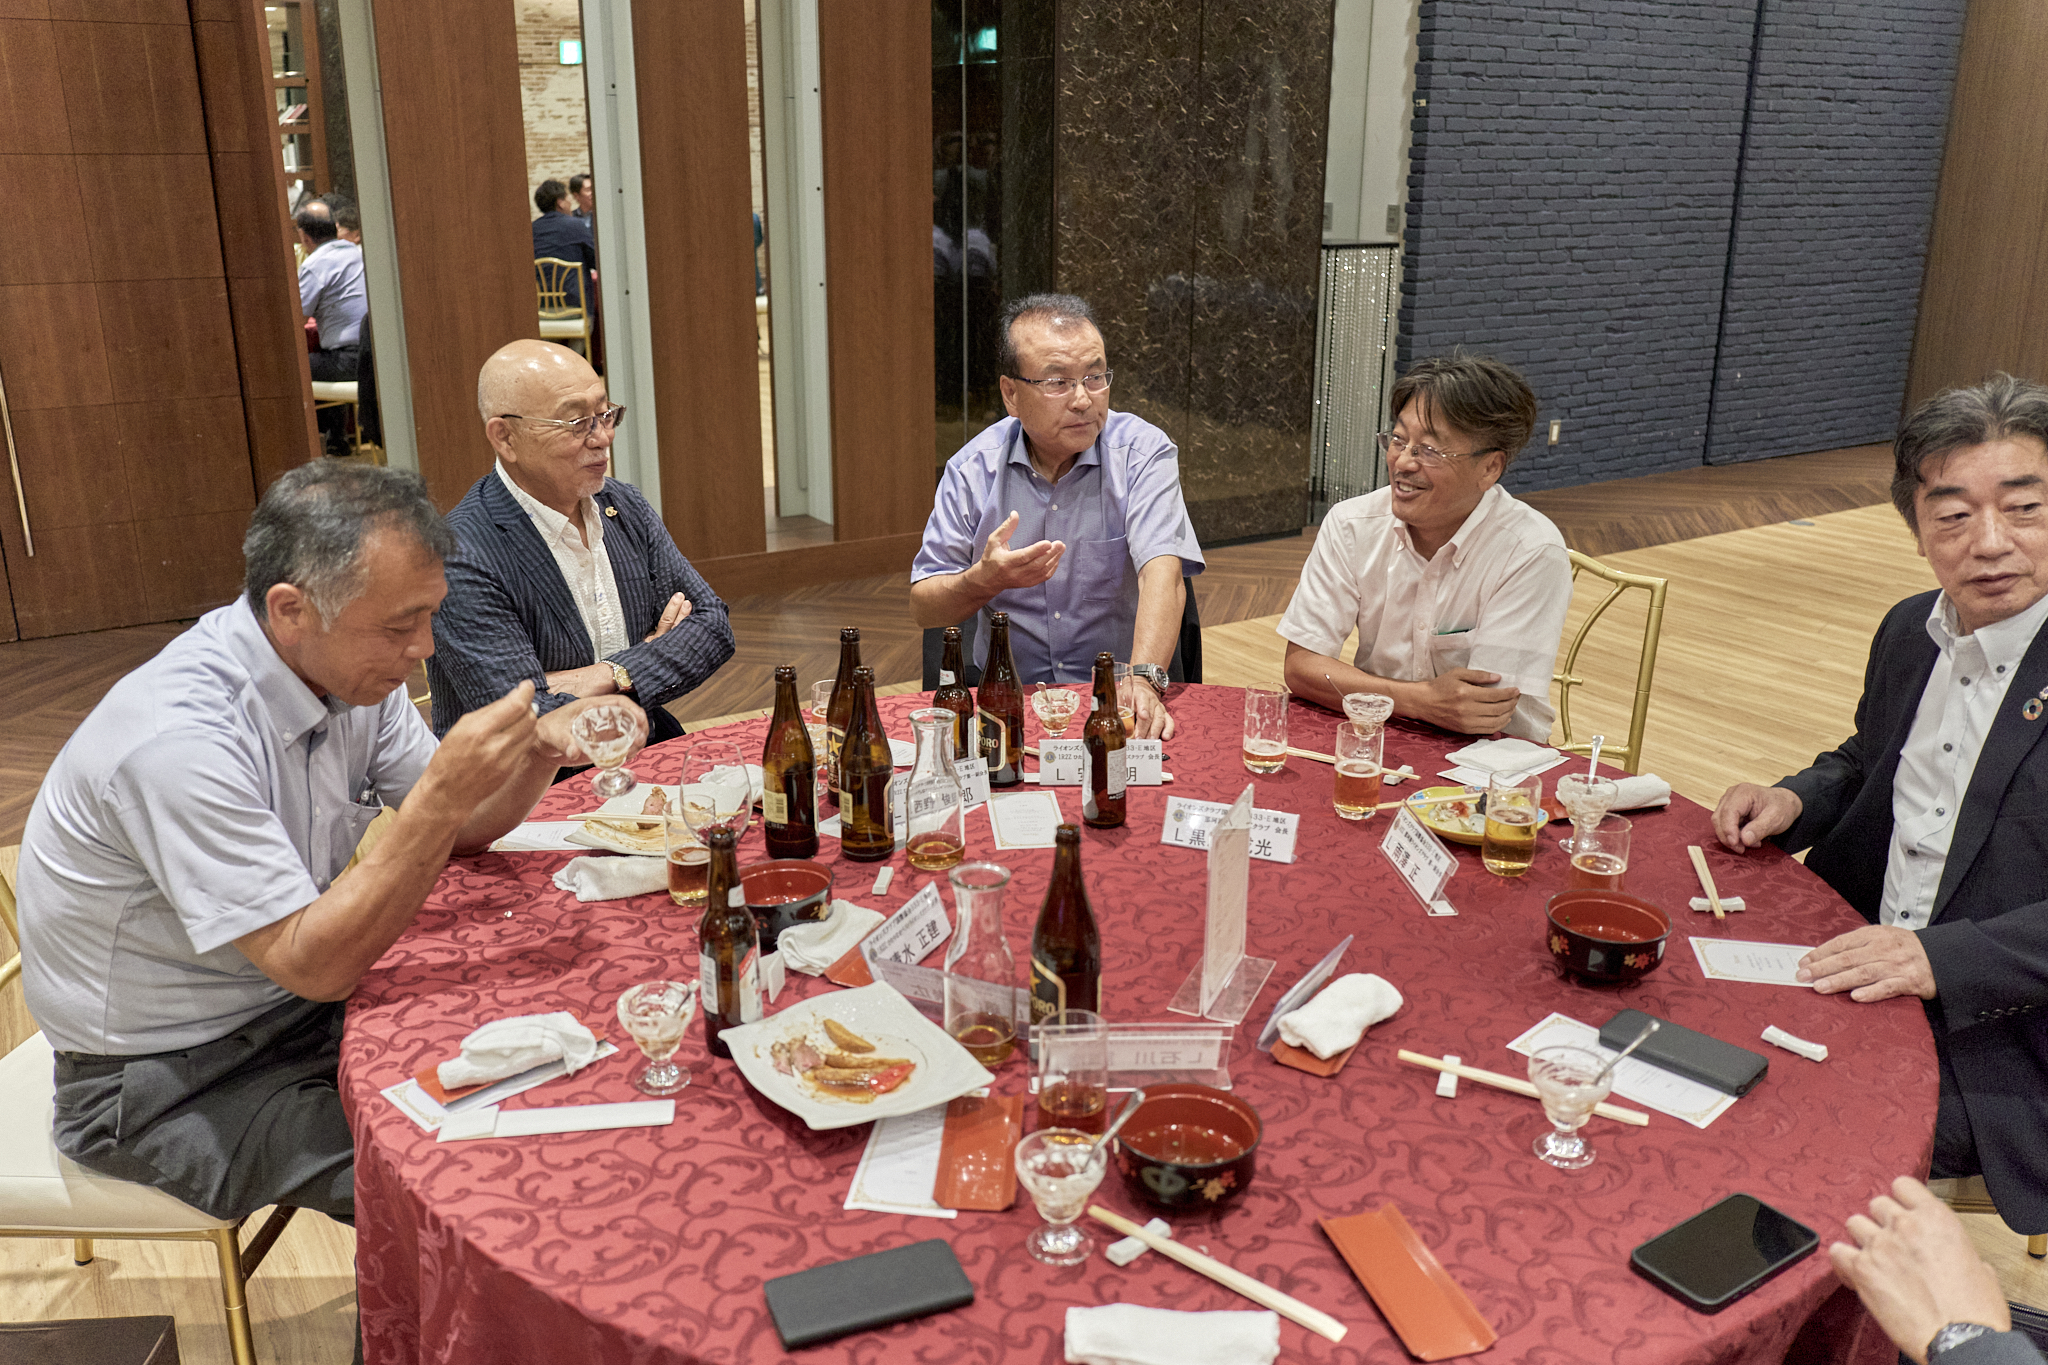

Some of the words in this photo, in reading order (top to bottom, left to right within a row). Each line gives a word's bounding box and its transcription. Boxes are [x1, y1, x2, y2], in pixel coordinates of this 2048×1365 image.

[1056, 767, 1065, 781] L
[1174, 827, 1184, 842] L
[1408, 863, 1421, 882] 正
